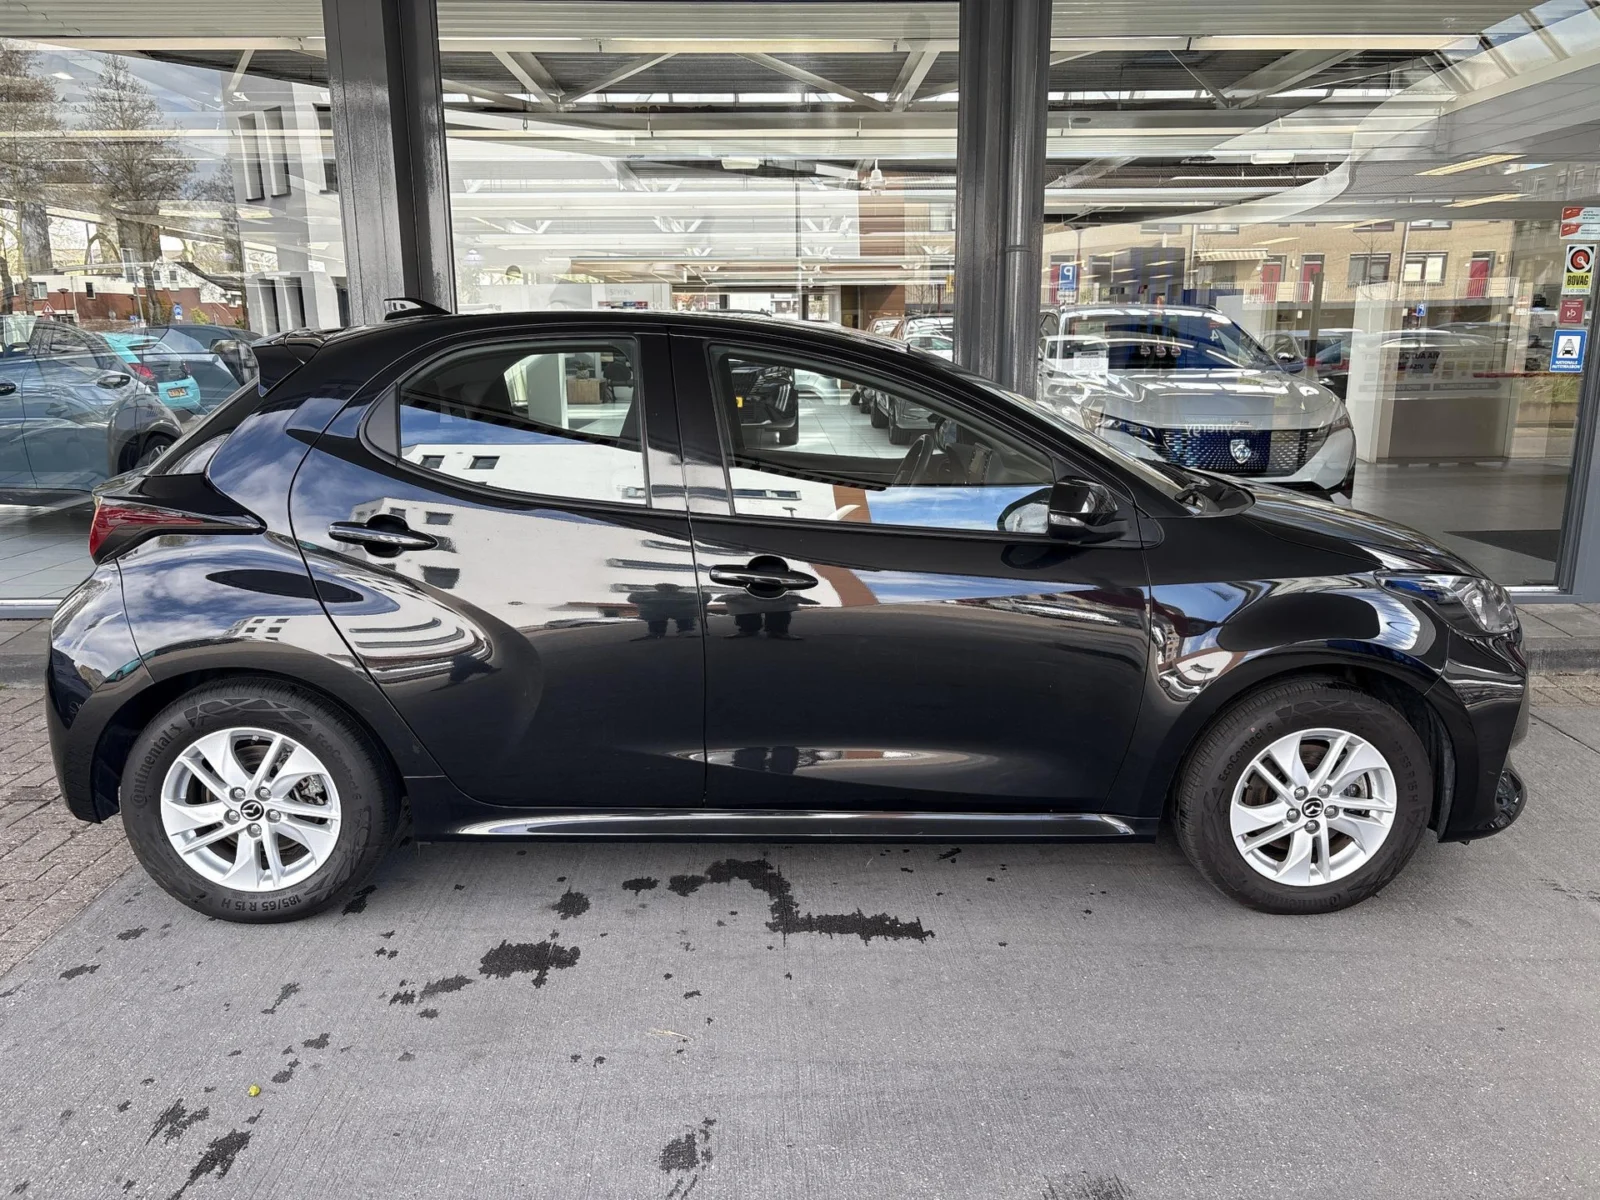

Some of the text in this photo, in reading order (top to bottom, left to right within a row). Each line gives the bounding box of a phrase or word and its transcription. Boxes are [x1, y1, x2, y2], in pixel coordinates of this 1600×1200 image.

[1566, 275, 1589, 286] BOVAG
[1217, 722, 1274, 782] EcoContact 6
[130, 728, 176, 809] Continental
[221, 897, 231, 909] H
[235, 900, 246, 911] 15
[248, 901, 257, 912] R
[261, 894, 302, 911] 185/65
